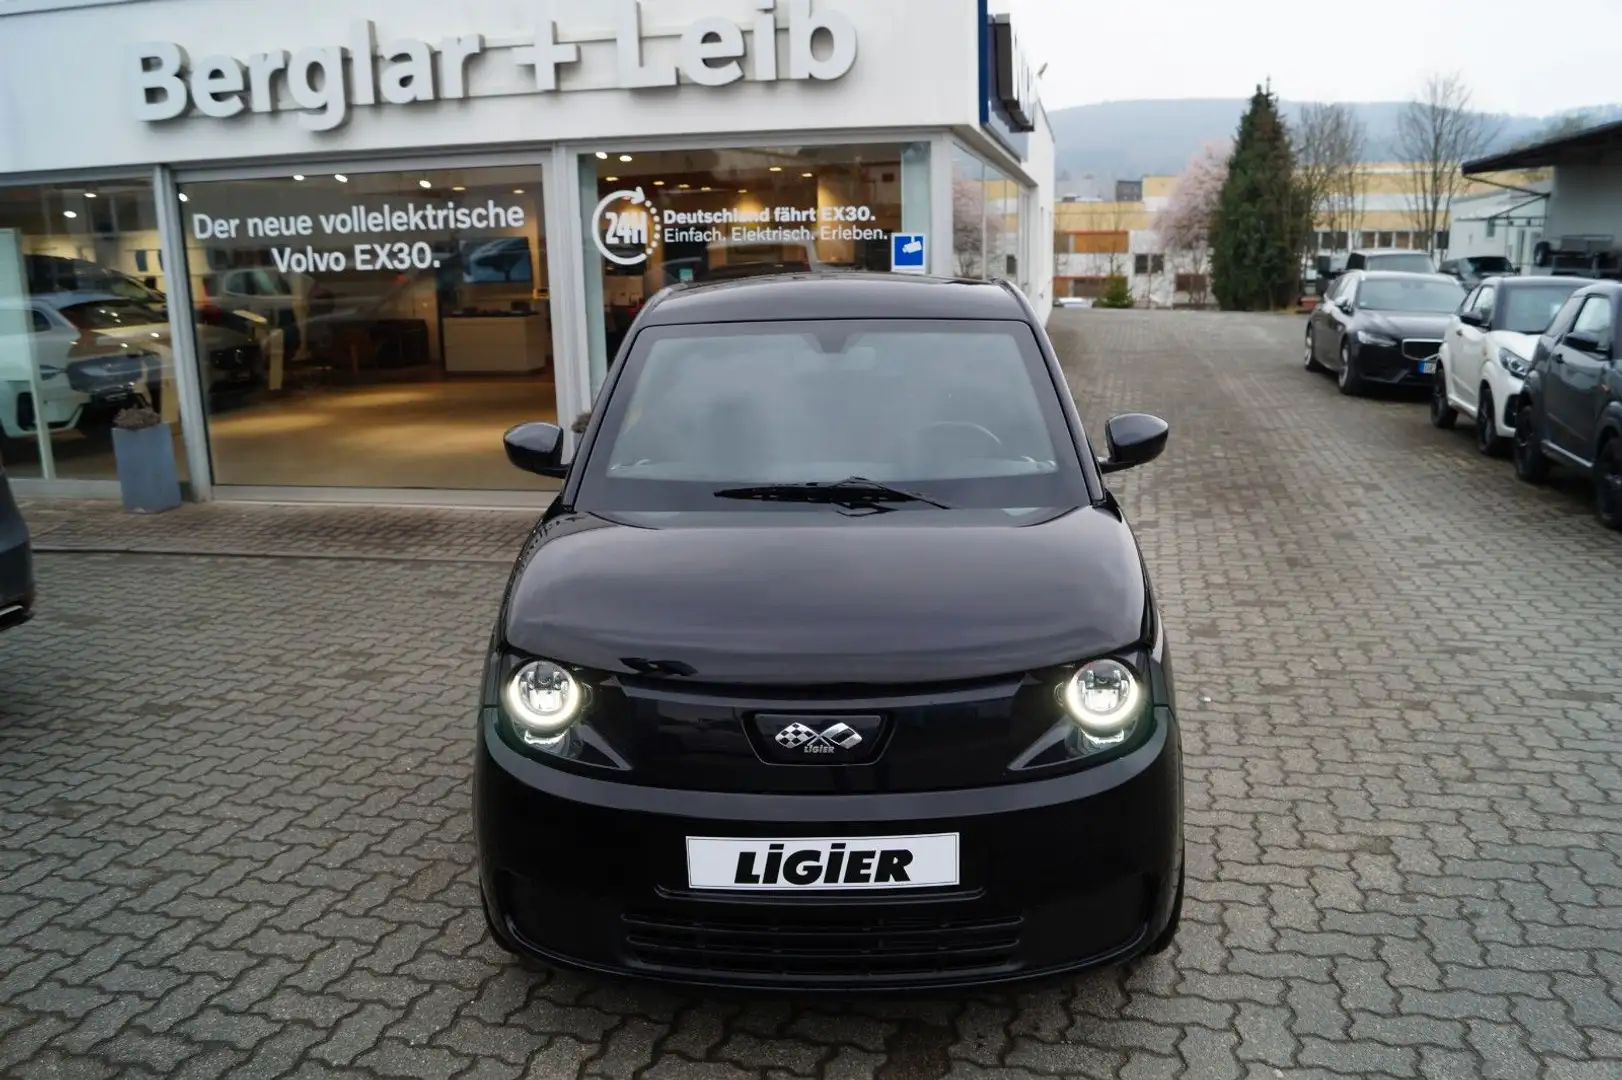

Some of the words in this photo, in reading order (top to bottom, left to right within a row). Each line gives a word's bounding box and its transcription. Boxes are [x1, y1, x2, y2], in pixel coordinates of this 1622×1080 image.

[137, 20, 485, 131] Berglar
[515, 20, 578, 91] +
[615, 0, 857, 88] Leib
[193, 213, 240, 240] Der
[247, 215, 313, 237] neue
[319, 200, 525, 234] vollelektrische
[605, 211, 648, 245] 24H
[663, 207, 770, 224] Deutschland
[774, 206, 816, 222] fährt
[821, 206, 876, 222] EX30.
[664, 226, 726, 243] Einfach.
[731, 225, 815, 242] Elektrisch.
[820, 223, 888, 241] Erleben.
[271, 245, 346, 273] Volvo
[354, 241, 441, 271] EX30.
